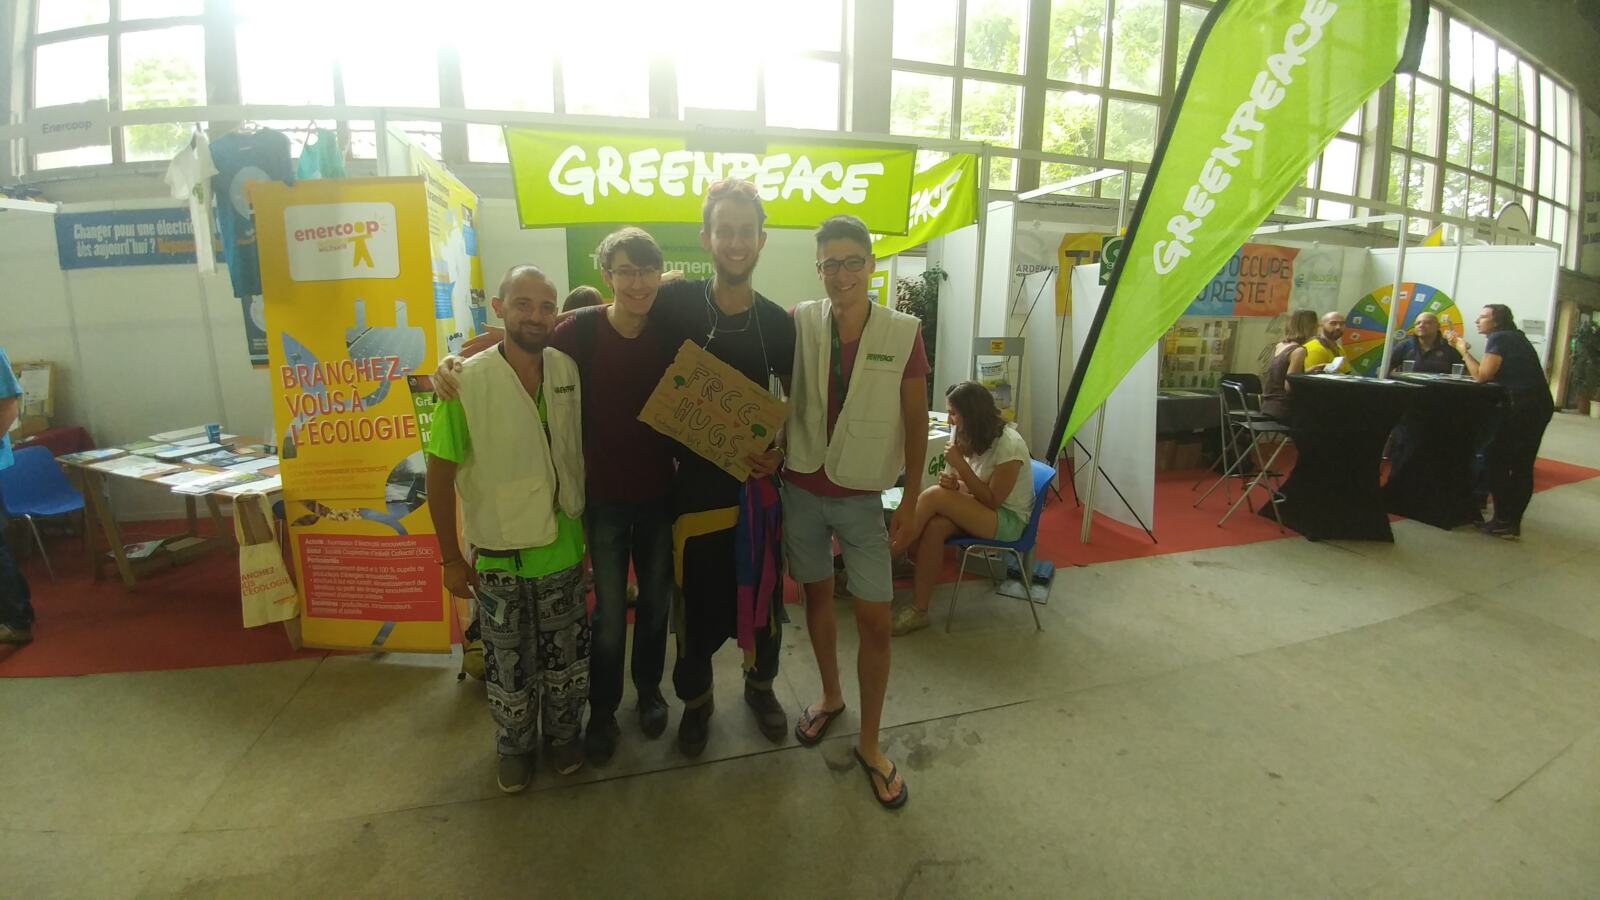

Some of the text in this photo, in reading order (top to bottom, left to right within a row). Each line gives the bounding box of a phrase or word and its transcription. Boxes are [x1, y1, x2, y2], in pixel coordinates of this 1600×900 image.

[1153, 0, 1338, 274] GREENPEACE
[548, 145, 885, 205] GREENPEACE
[74, 218, 195, 242] Changer pour une électri
[294, 220, 380, 242] enercoop
[94, 237, 148, 259] aujourd'hui
[1217, 255, 1289, 279] OCCUPE
[1211, 280, 1267, 303] RESTE
[280, 355, 412, 389] BRANCHEZ-
[285, 384, 365, 418] VOUS À
[290, 414, 417, 447] L'ÉCOLOGIE
[673, 397, 744, 459] HUGS
